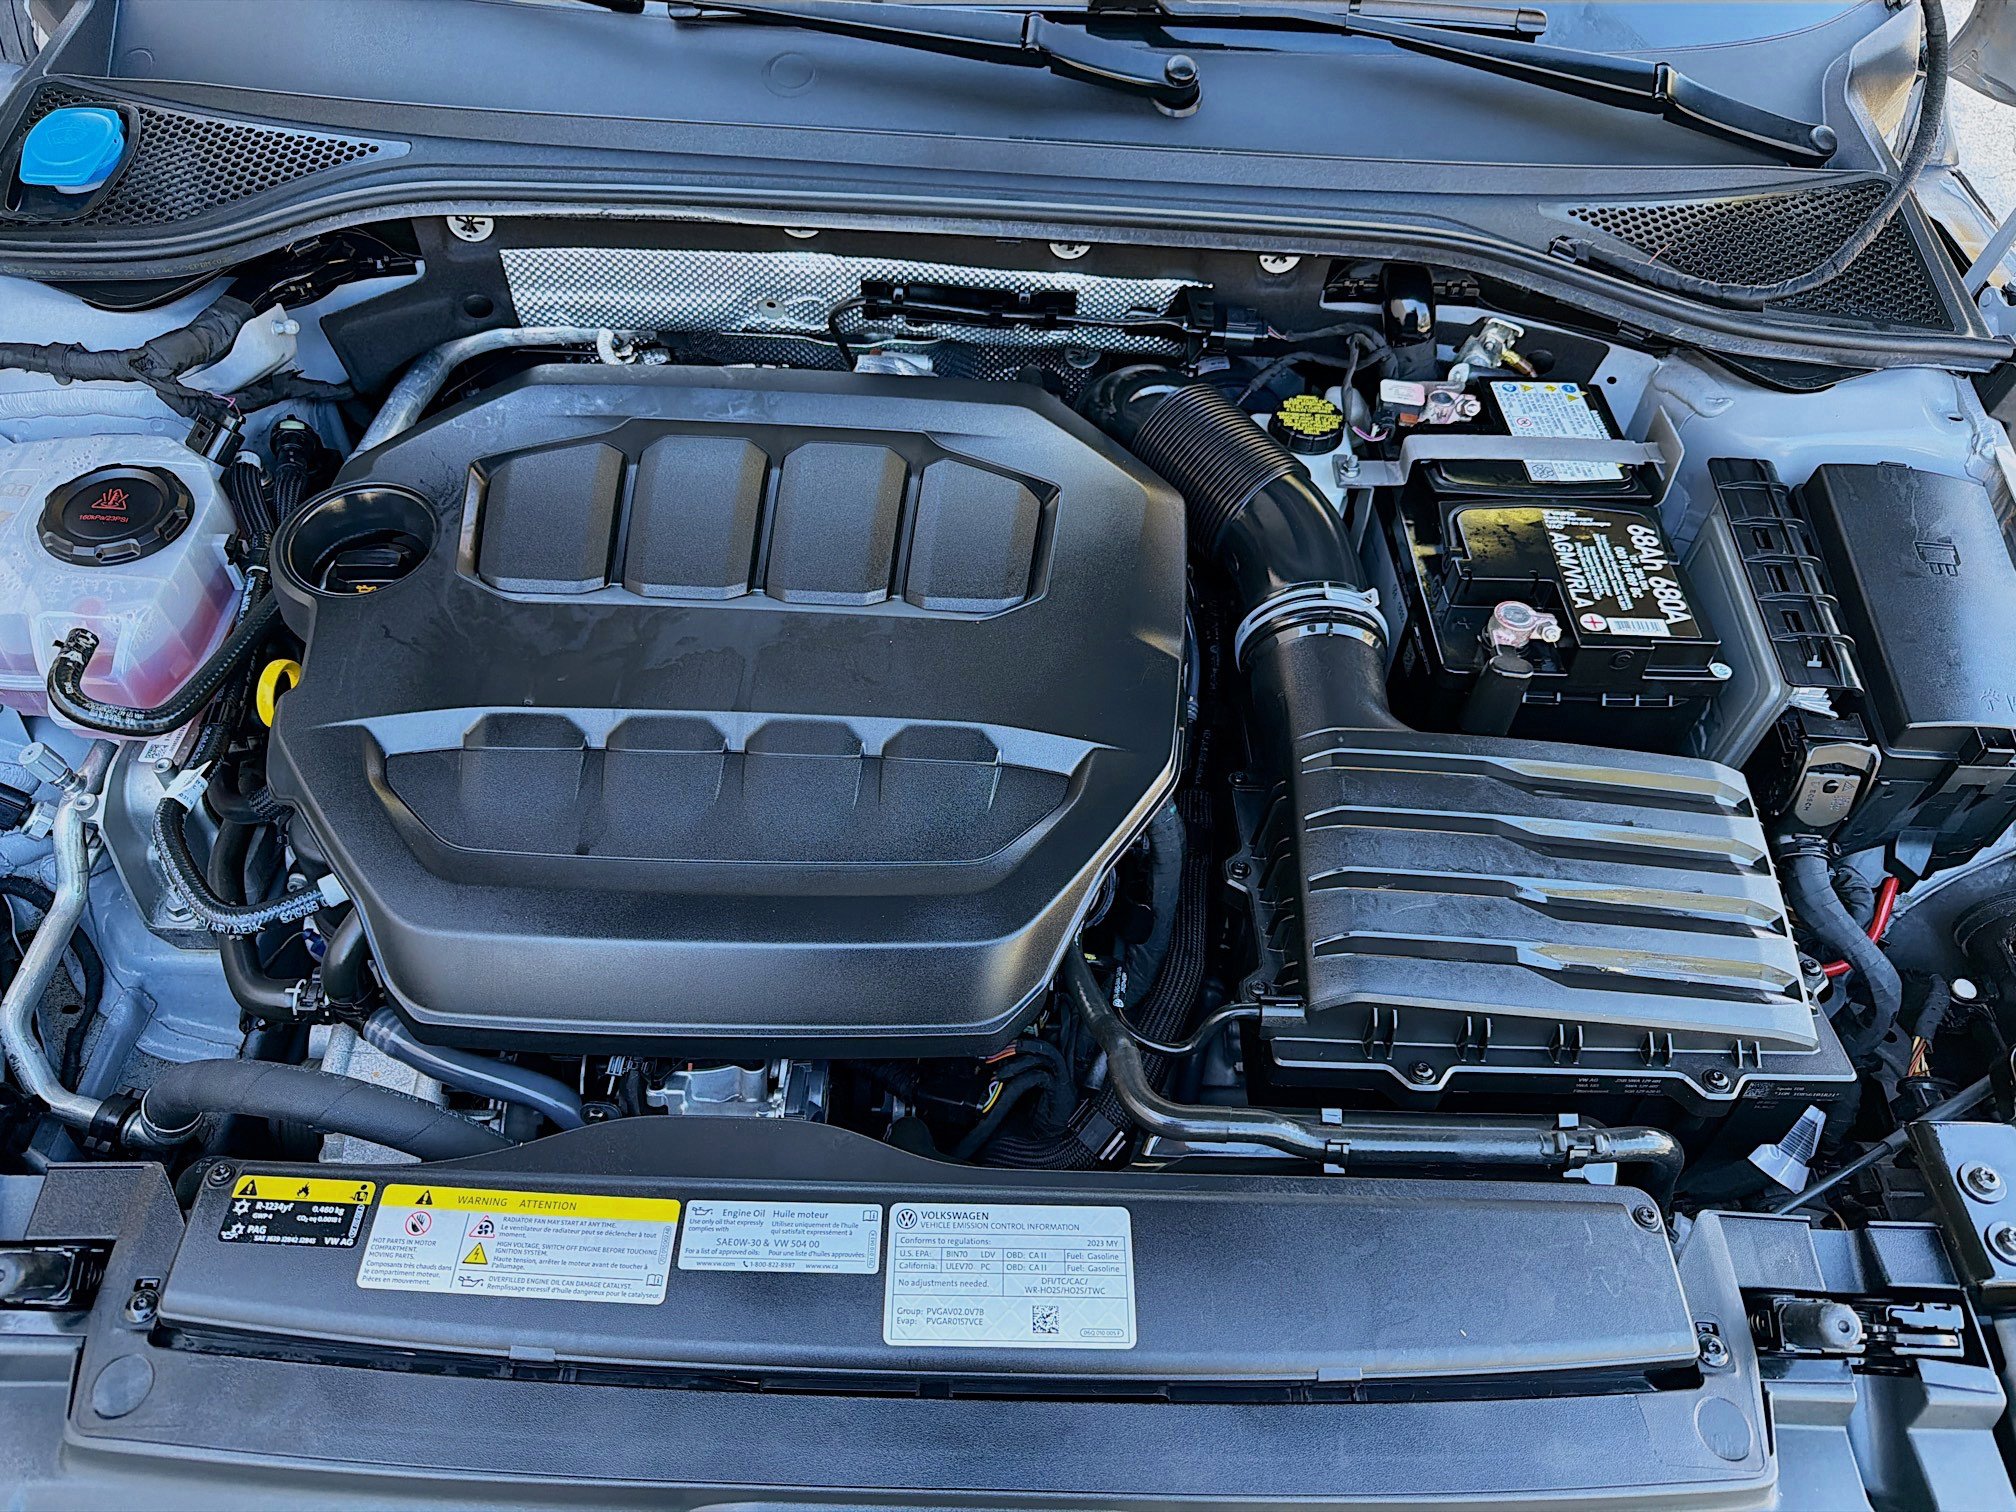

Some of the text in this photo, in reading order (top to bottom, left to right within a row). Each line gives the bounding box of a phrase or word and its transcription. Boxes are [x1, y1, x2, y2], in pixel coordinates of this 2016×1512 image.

[1627, 525, 1691, 624] 68Ah 680A
[456, 1195, 577, 1210] WARNING ATTENTION
[255, 1202, 345, 1216] R-1234yf 0.460 kg
[722, 1208, 751, 1218] Engine
[921, 1211, 988, 1220] VOLKSWAGEN
[247, 1225, 267, 1234] PAG
[324, 1236, 353, 1246] VW AG
[947, 1237, 990, 1246] regulations:
[365, 1260, 403, 1270] Composants
[370, 1268, 415, 1278] compartiment
[910, 1279, 957, 1288] adjustments
[486, 1283, 525, 1292] Remplissage
[572, 1289, 604, 1297] dangereux
[897, 1307, 923, 1316] Group:
[896, 1317, 916, 1326] Evap:
